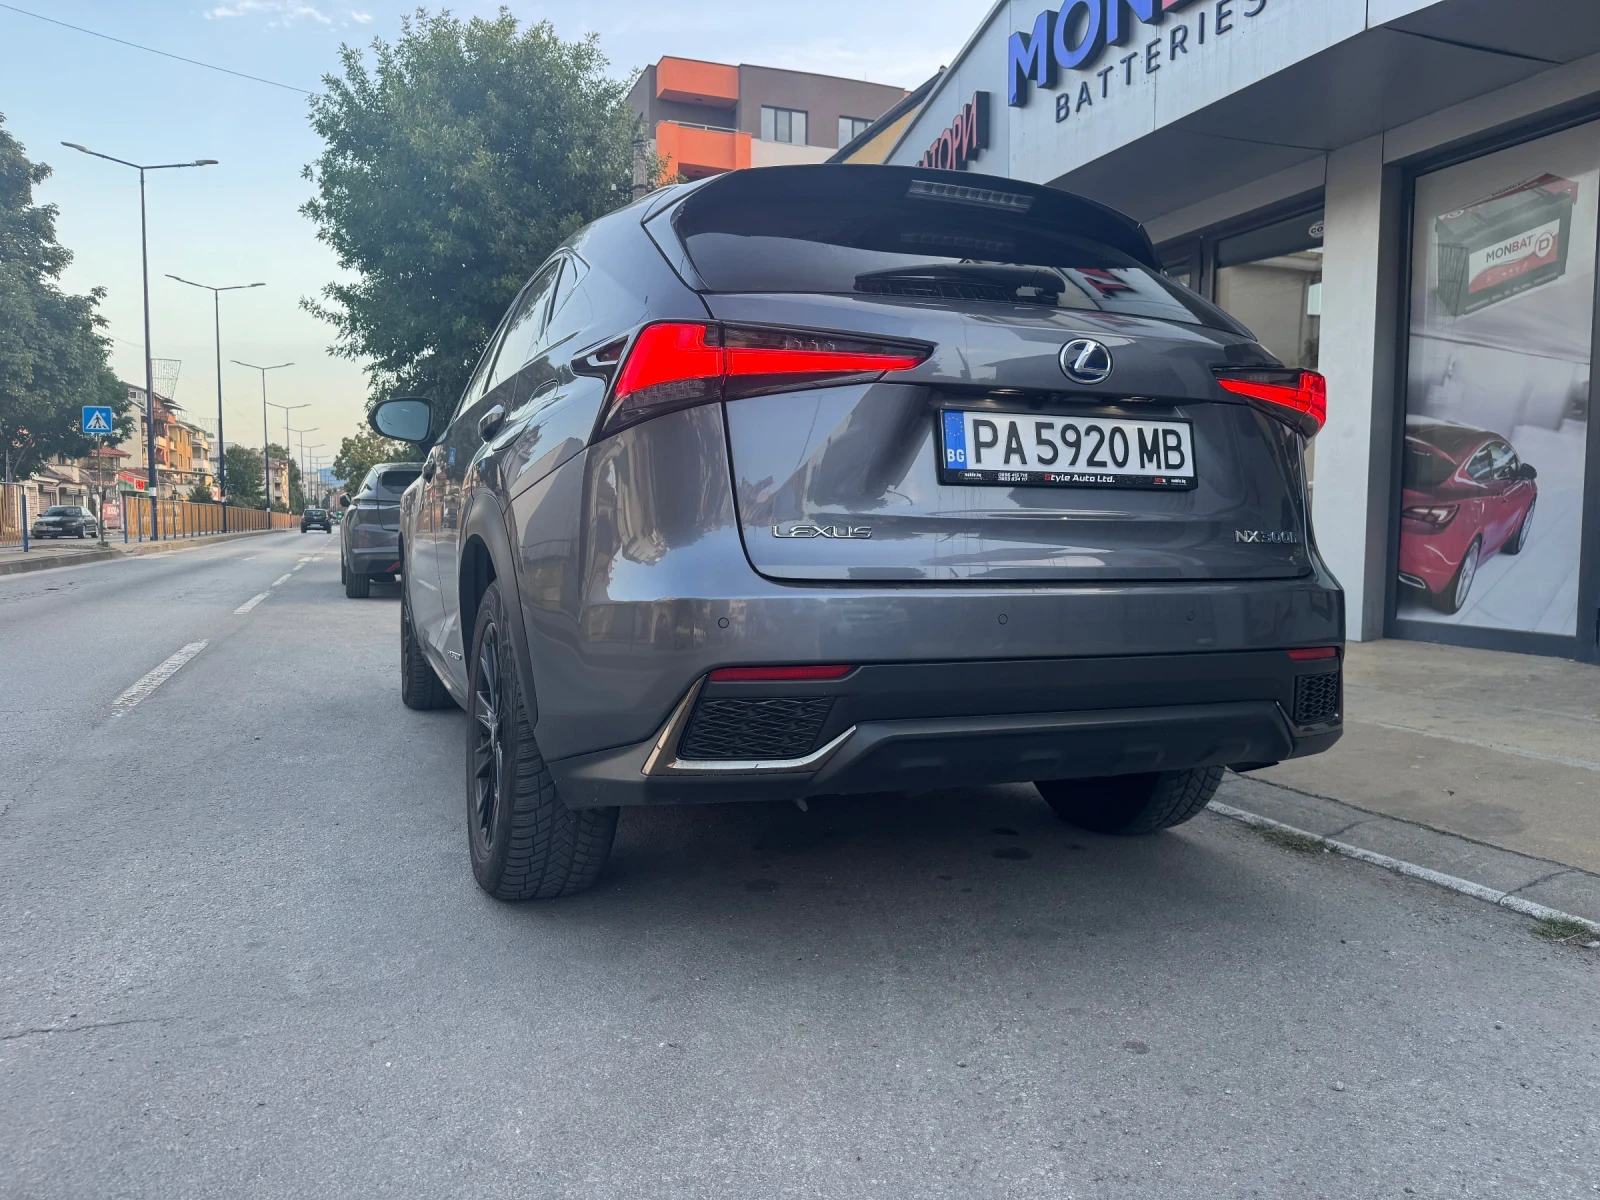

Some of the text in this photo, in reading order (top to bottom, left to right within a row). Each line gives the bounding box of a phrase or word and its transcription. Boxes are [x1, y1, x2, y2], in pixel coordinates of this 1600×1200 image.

[1008, 0, 1197, 106] MON
[1485, 234, 1534, 263] MONBAT
[947, 448, 965, 463] BG
[1072, 474, 1095, 482] Auto
[1097, 475, 1115, 483] Ltd.
[772, 525, 872, 539] LEXUS
